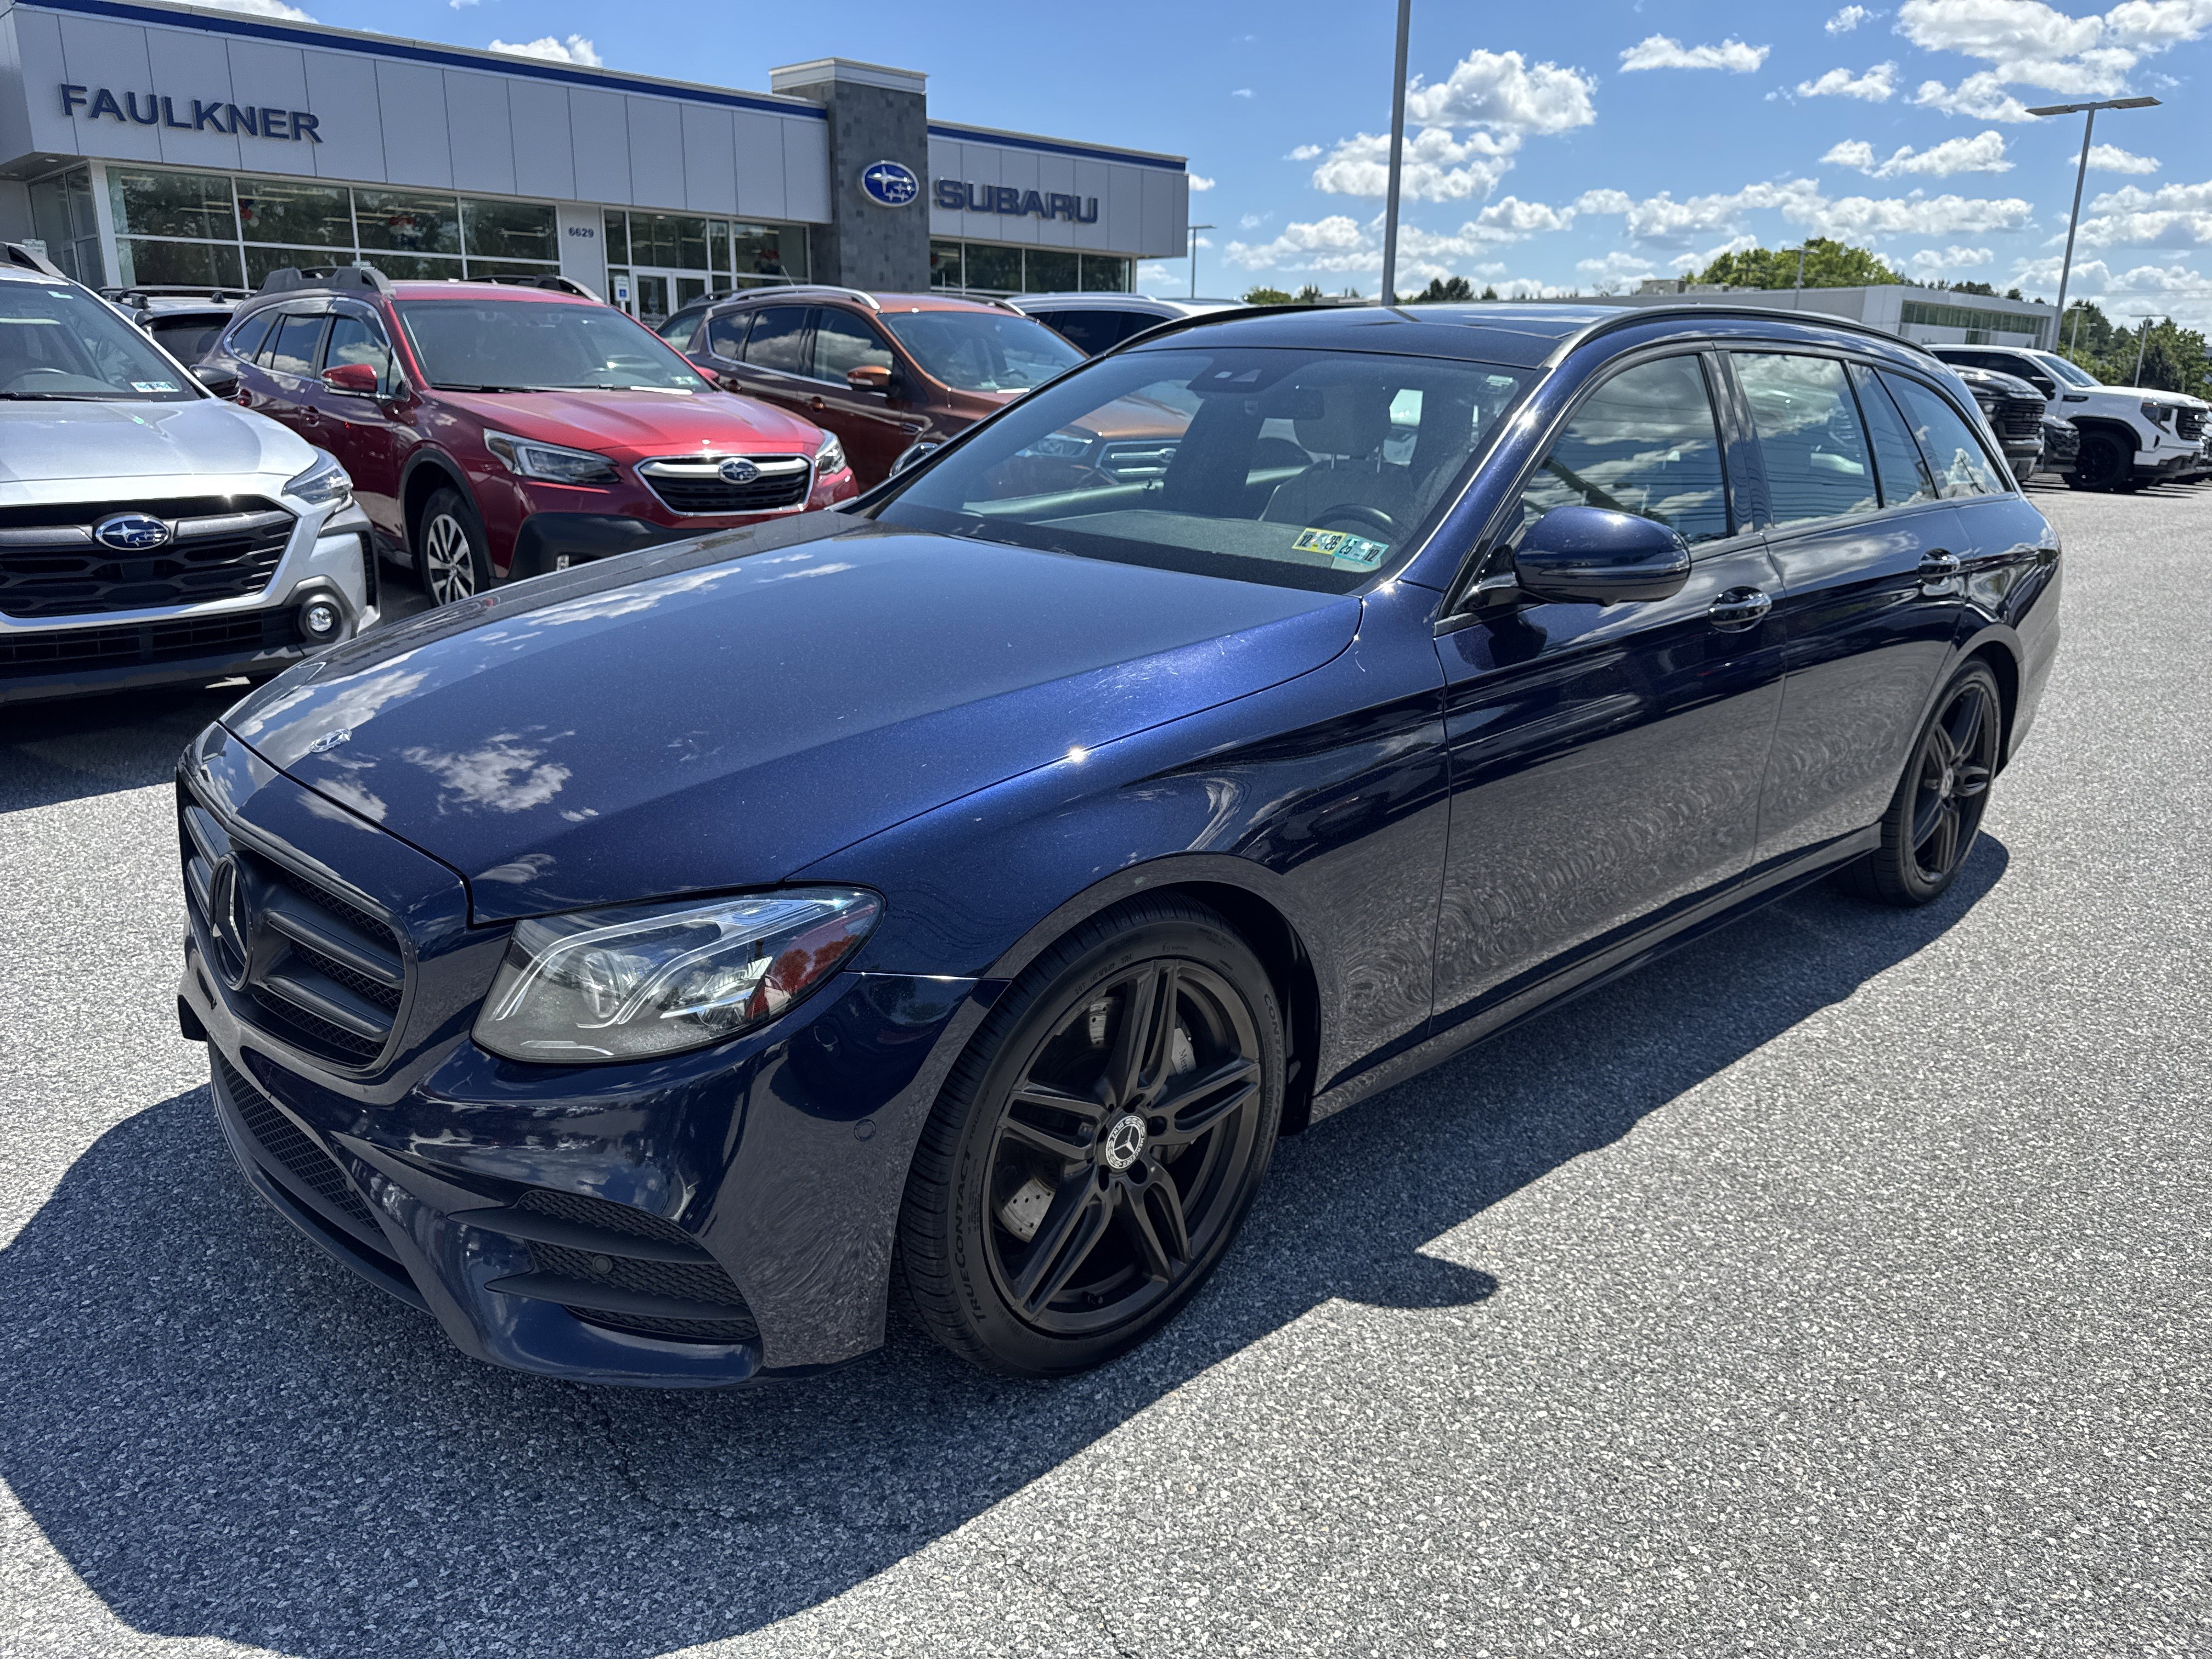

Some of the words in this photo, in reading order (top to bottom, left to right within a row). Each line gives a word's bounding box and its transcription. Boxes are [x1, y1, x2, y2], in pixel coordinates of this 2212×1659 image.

[59, 83, 324, 144] FAULKNER
[935, 179, 1098, 224] SUBARU
[568, 227, 595, 238] 6629
[1298, 534, 1313, 547] 12
[1363, 548, 1380, 562] 12
